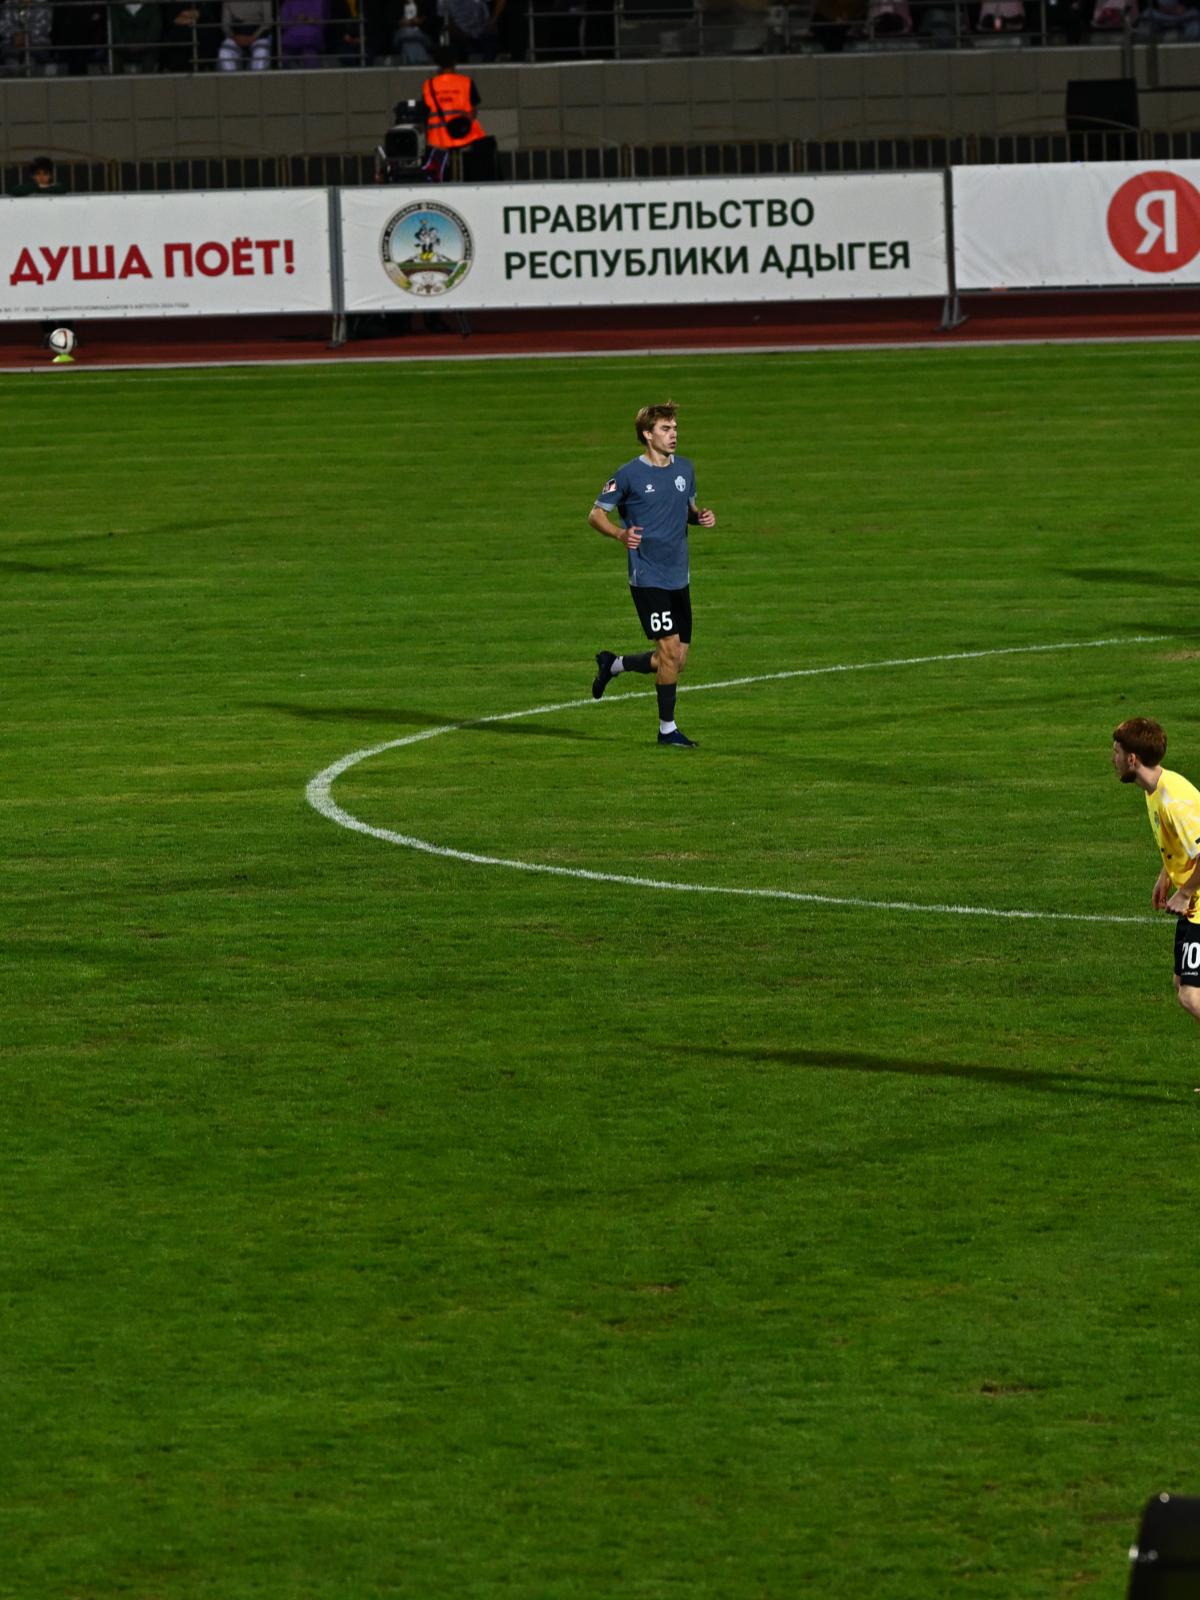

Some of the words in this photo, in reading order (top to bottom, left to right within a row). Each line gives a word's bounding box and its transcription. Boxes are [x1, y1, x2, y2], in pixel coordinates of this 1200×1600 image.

[502, 197, 815, 234] ПРАВИТЕЛЬСТВО
[1135, 189, 1178, 254] Я
[9, 243, 153, 286] ДУША
[163, 236, 296, 278] ПОЁТ!
[504, 245, 750, 280] РЕСПУБЛИКИ
[759, 240, 911, 279] АДЫГЕЯ
[650, 611, 673, 632] 65
